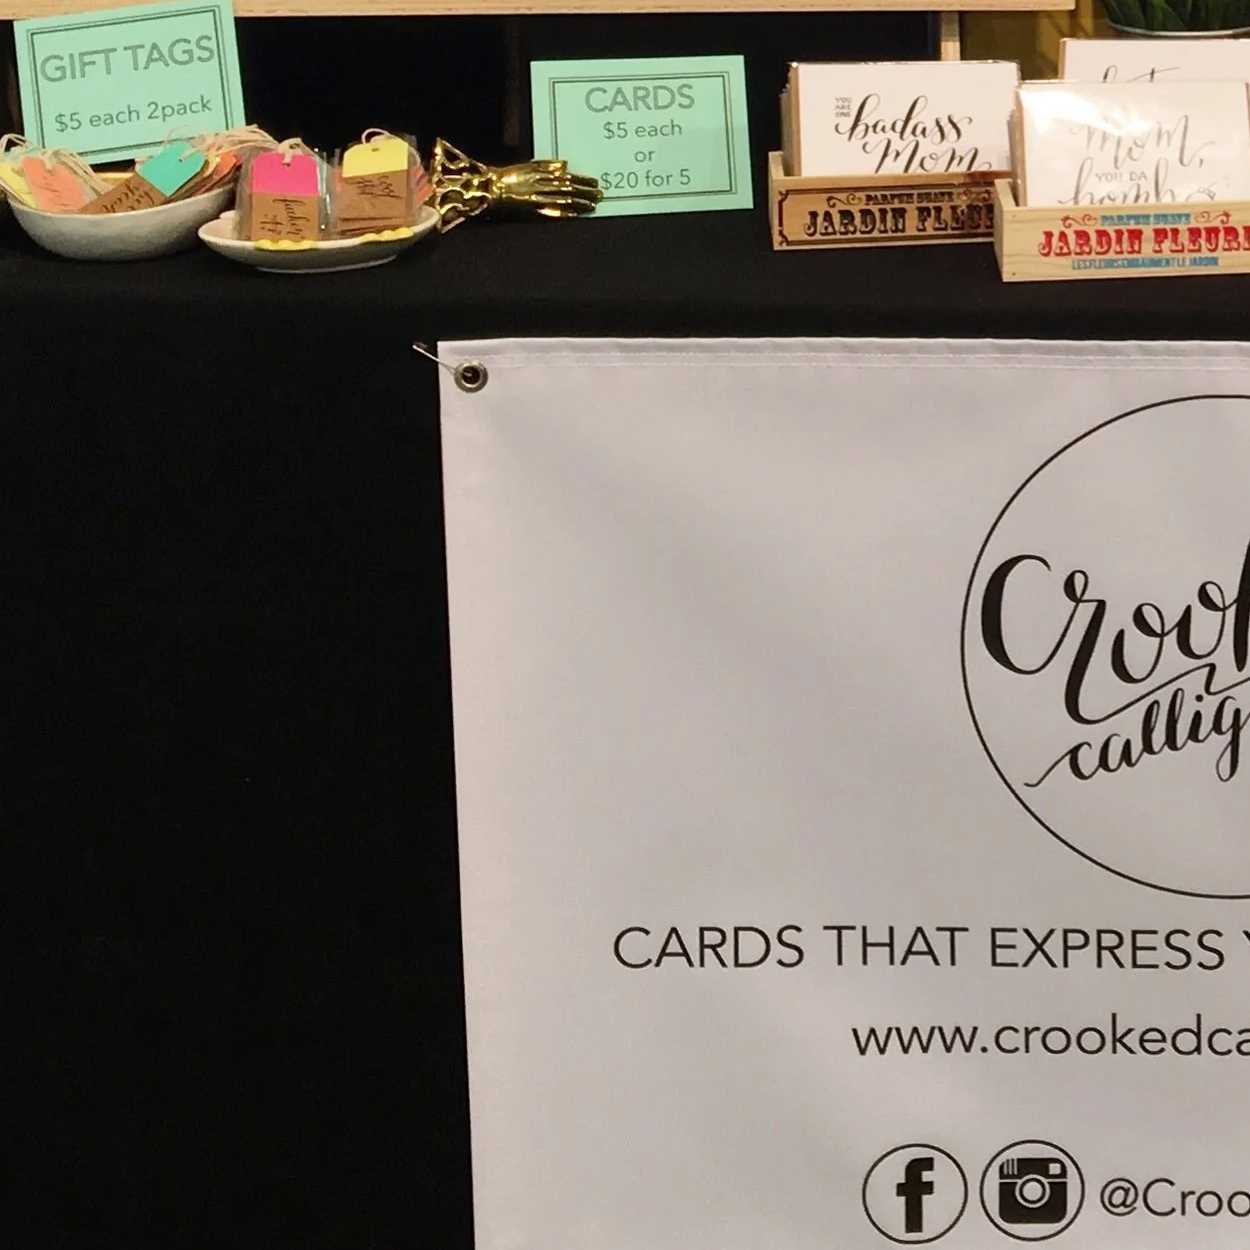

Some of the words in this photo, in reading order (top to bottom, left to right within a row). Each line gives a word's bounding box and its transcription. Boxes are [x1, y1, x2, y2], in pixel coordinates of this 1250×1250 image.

[40, 47, 118, 83] GIFT
[123, 35, 216, 75] TAGS
[54, 112, 83, 133] $5
[88, 104, 140, 129] each
[147, 94, 212, 121] 2pack
[584, 84, 695, 113] CARDS
[603, 121, 628, 140] $5
[635, 119, 682, 138] each
[834, 93, 972, 145] badass
[634, 150, 656, 163] or
[862, 138, 992, 174] Mom
[600, 171, 638, 191] $20
[645, 169, 673, 187] for
[679, 169, 691, 185] 5
[1129, 171, 1148, 181] DA
[805, 207, 907, 237] JARDIN
[916, 203, 994, 233] FLEU
[1038, 228, 1143, 257] JARDIN
[614, 925, 804, 968] CARDS
[823, 926, 969, 966] THAT
[991, 928, 1224, 970] EXPRESS
